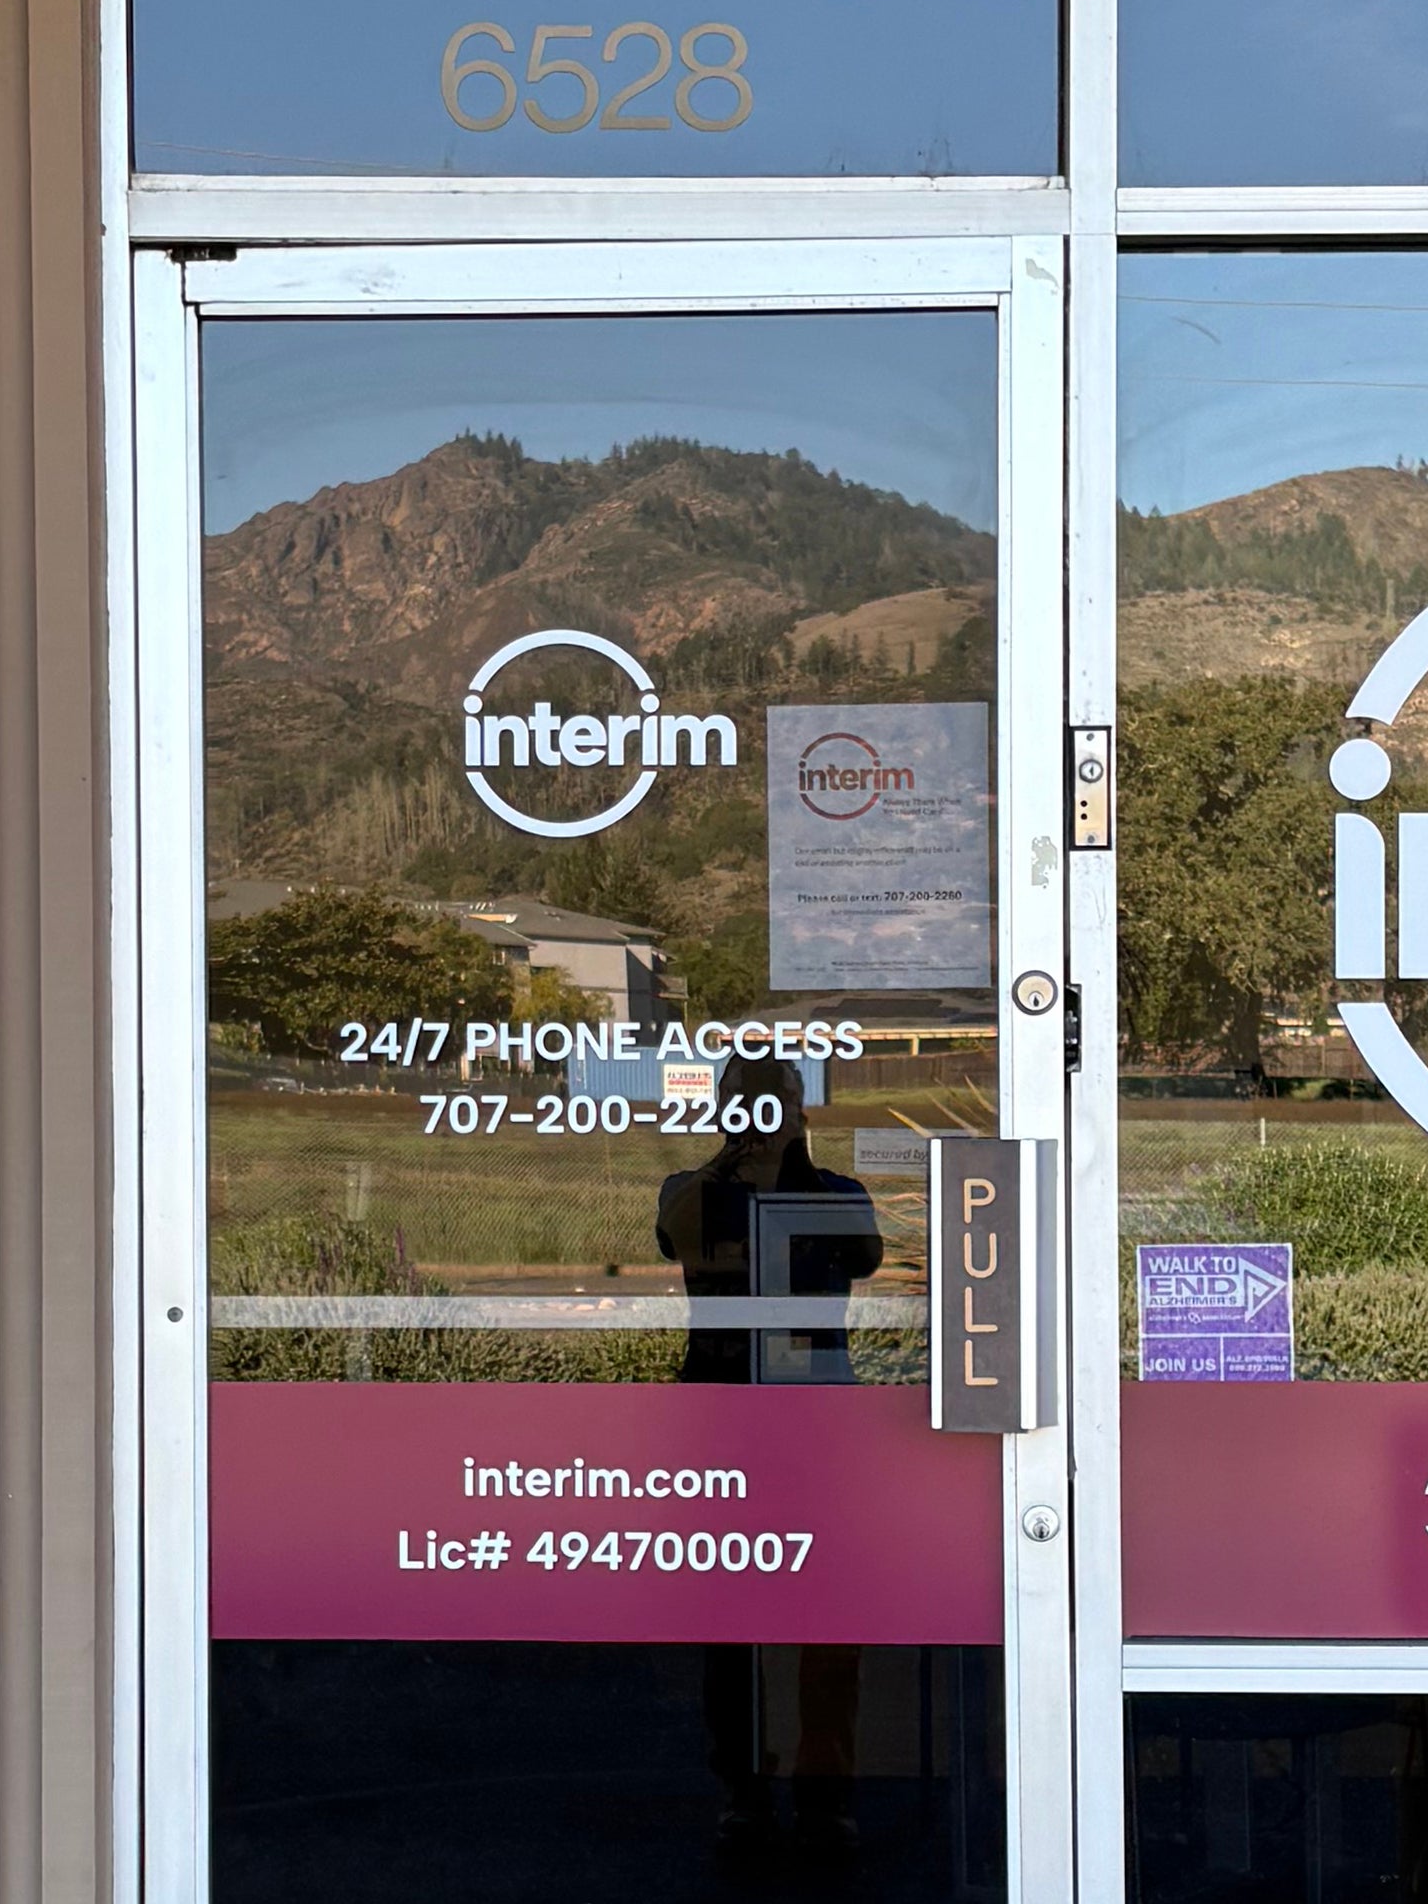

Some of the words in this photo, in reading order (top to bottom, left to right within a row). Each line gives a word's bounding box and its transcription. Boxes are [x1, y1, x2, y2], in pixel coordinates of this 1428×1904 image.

[439, 21, 754, 133] 6528
[463, 694, 738, 767] interim
[798, 759, 915, 791] interim
[340, 1017, 451, 1067] 24/7
[465, 1021, 641, 1061] PHONE
[655, 1021, 865, 1061] ACCESS
[419, 1094, 783, 1134] 707-200-2260
[963, 1178, 999, 1386] PULL
[1148, 1256, 1207, 1273] WALK
[1211, 1256, 1236, 1273] TO
[1149, 1277, 1237, 1296] END
[1145, 1358, 1186, 1372] JOIN
[1192, 1358, 1216, 1372] US
[463, 1457, 748, 1499] interim.com
[398, 1530, 510, 1571] Lic#
[526, 1531, 815, 1573] 494700007
